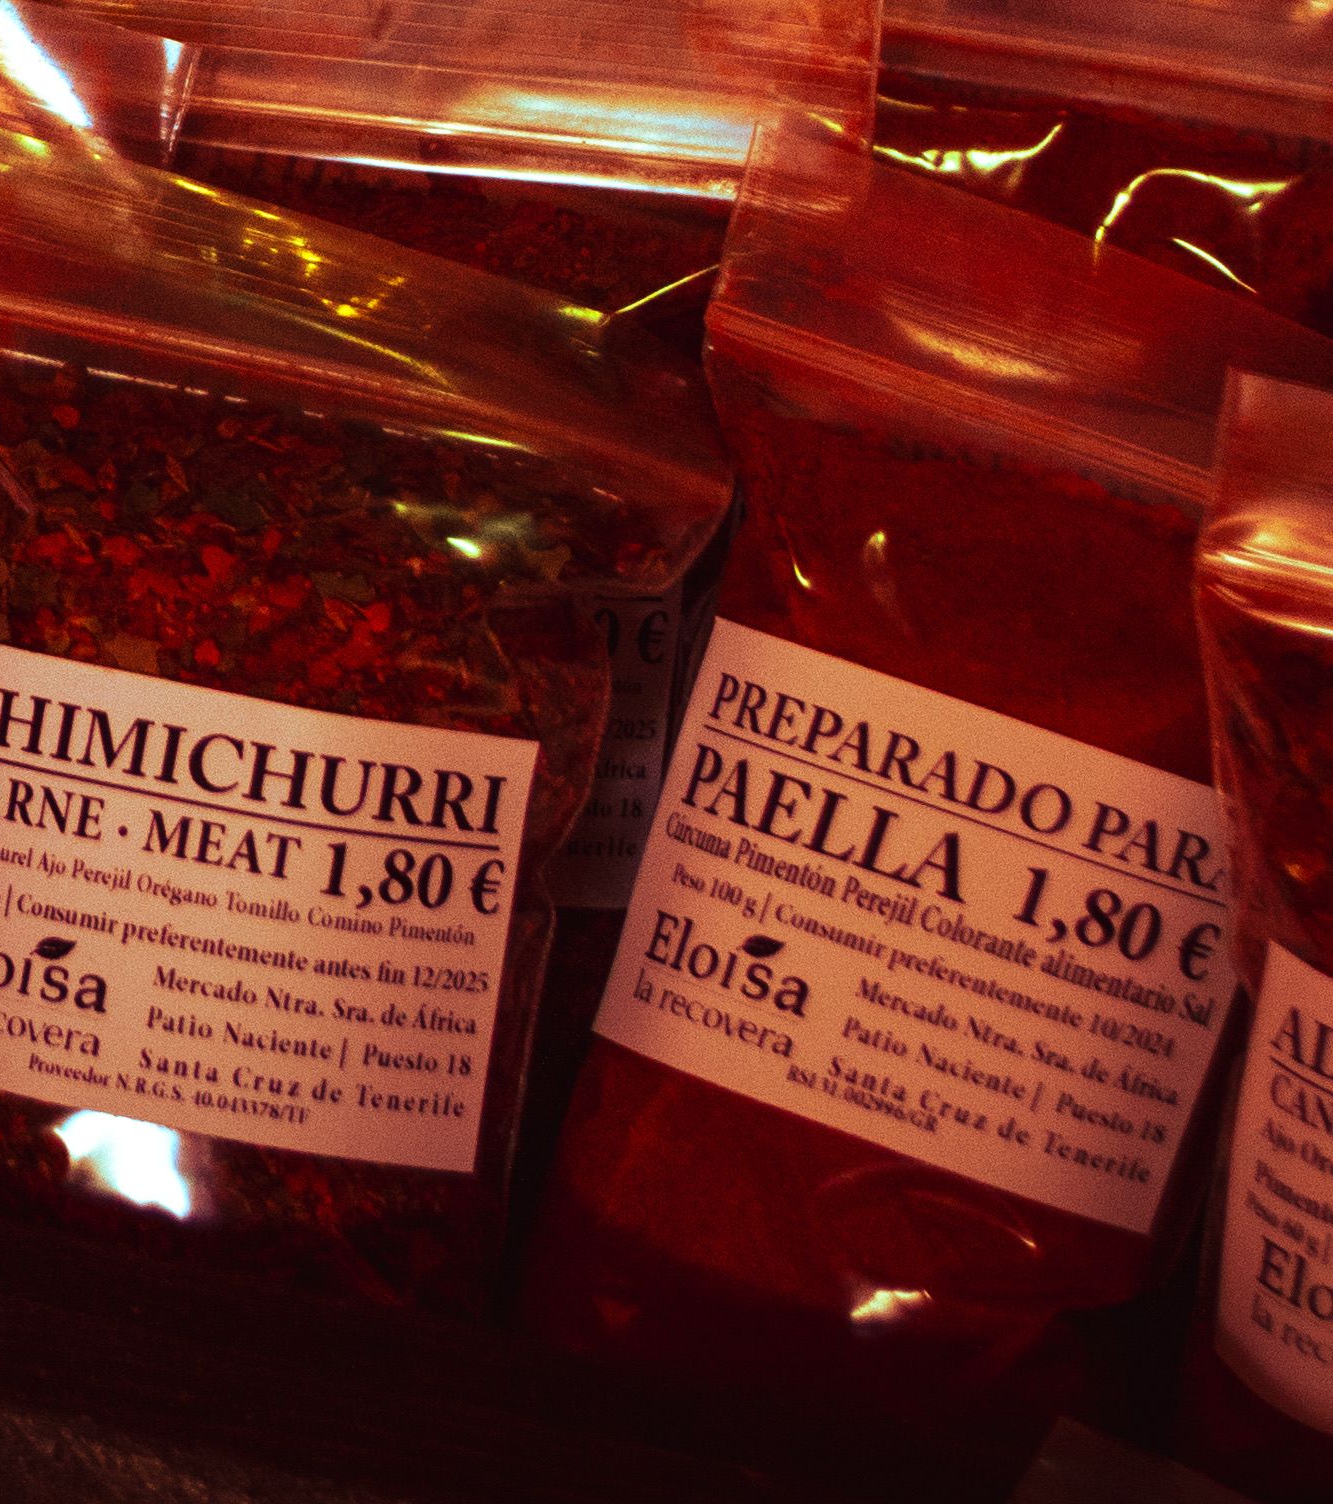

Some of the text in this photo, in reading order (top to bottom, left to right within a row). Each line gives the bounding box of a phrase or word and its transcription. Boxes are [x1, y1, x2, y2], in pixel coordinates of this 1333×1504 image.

[707, 670, 1226, 895] PREPARADO PAR
[141, 809, 303, 882] MEAT
[320, 842, 452, 912] 1,80
[470, 858, 507, 919] €
[681, 742, 1222, 983] PAELLA 1,80 €
[15, 891, 491, 994] Consumir preferentemente antes fin 12/2025
[225, 889, 301, 924] Tomillo
[307, 905, 383, 936] Comino
[152, 964, 479, 1037] Mercado Ntra. Sra. de África
[645, 908, 812, 1020] Eloísa
[145, 1004, 474, 1079] Patio Naciente Puesto 18
[658, 988, 796, 1060] recovera
[137, 1046, 466, 1122] Santa Cruz de Tenerife
